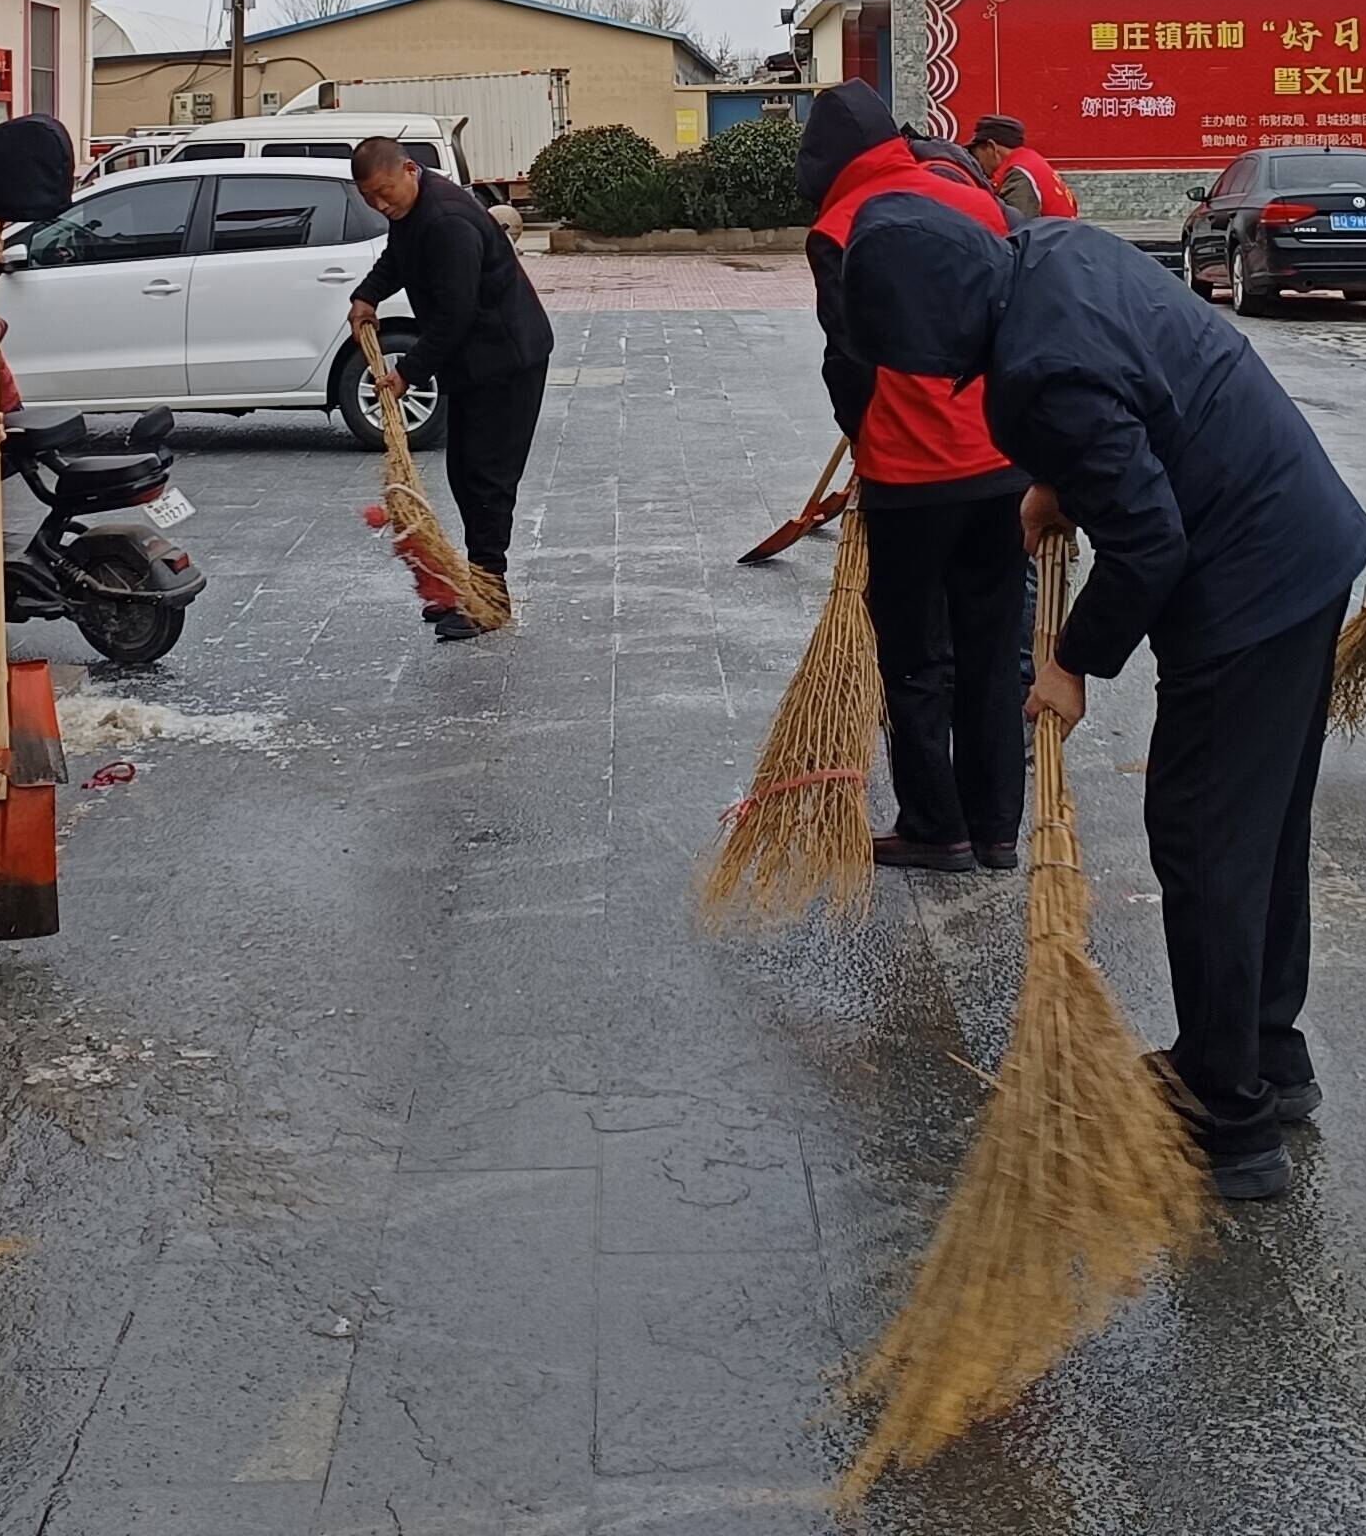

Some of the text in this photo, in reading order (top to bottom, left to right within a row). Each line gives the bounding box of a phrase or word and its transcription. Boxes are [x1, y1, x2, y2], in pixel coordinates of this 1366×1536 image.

[1081, 96, 1176, 117] 好日子善治
